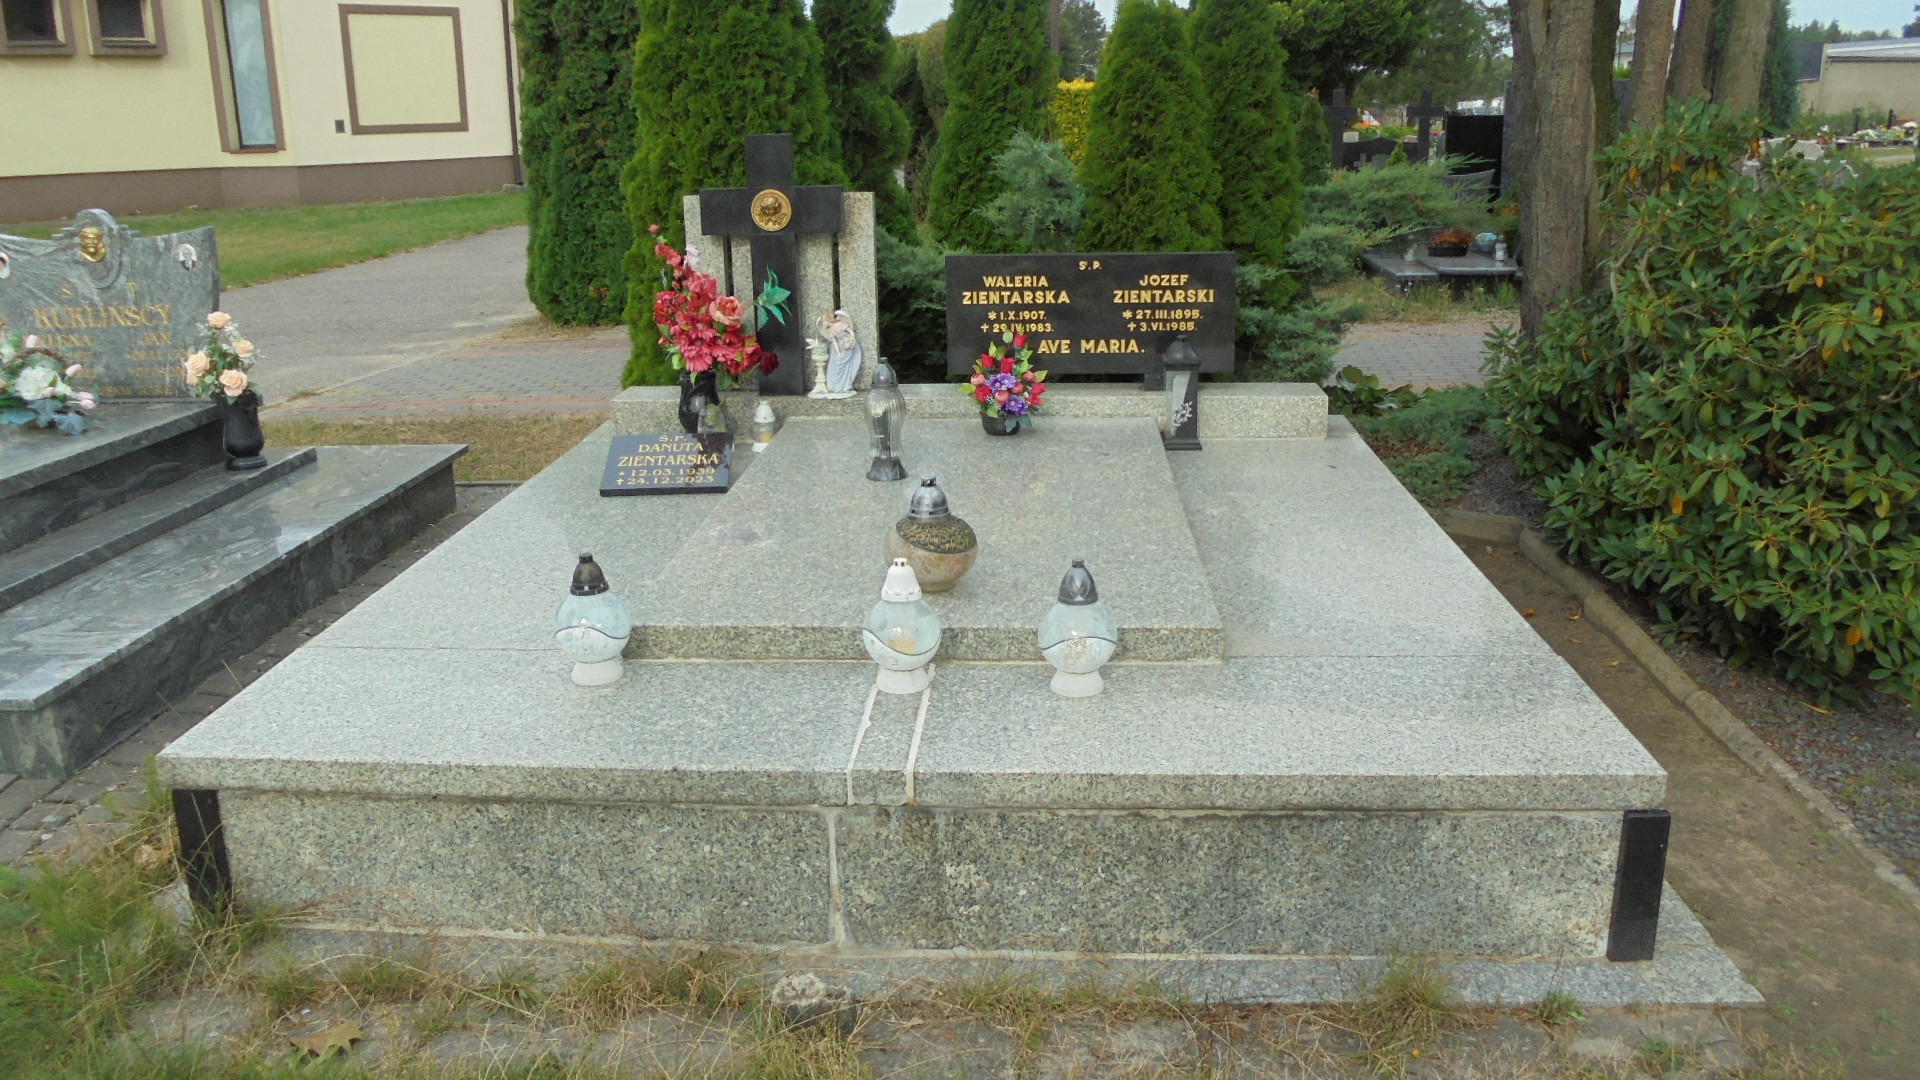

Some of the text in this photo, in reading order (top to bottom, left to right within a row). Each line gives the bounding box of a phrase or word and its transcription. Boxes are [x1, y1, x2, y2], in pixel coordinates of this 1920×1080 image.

[982, 275, 1049, 288] WALERIA
[962, 290, 1071, 305] ZIENTARSKA
[1113, 289, 1215, 303] ZIENTARSKI
[1037, 339, 1145, 354] AVE MARIA.
[638, 443, 704, 453] DANUTA
[617, 454, 719, 467] ZIENTARSKA
